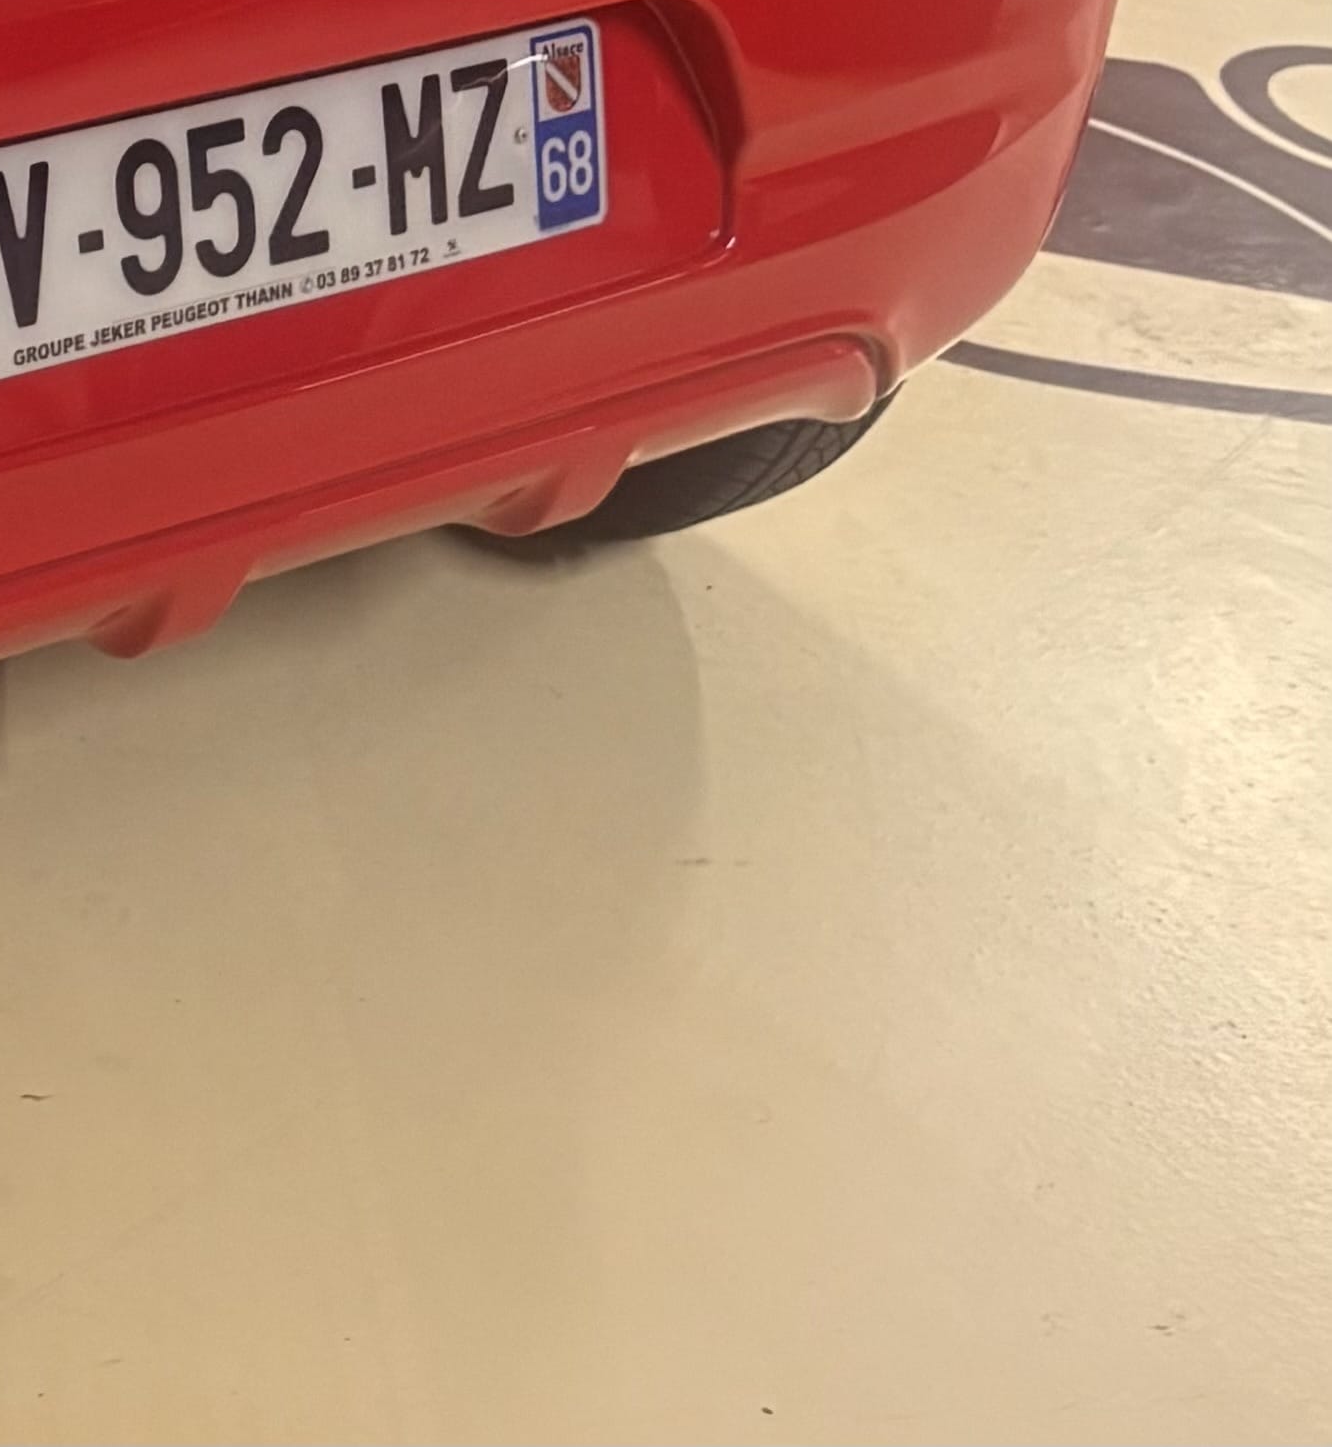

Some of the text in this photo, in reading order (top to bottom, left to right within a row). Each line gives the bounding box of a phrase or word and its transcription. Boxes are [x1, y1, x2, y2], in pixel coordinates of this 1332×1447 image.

[541, 41, 584, 62] Alsace
[541, 129, 594, 203] 68
[12, 246, 430, 367] GROUPE JEKER PEUGEOT THANN 03 89 37 81 72
